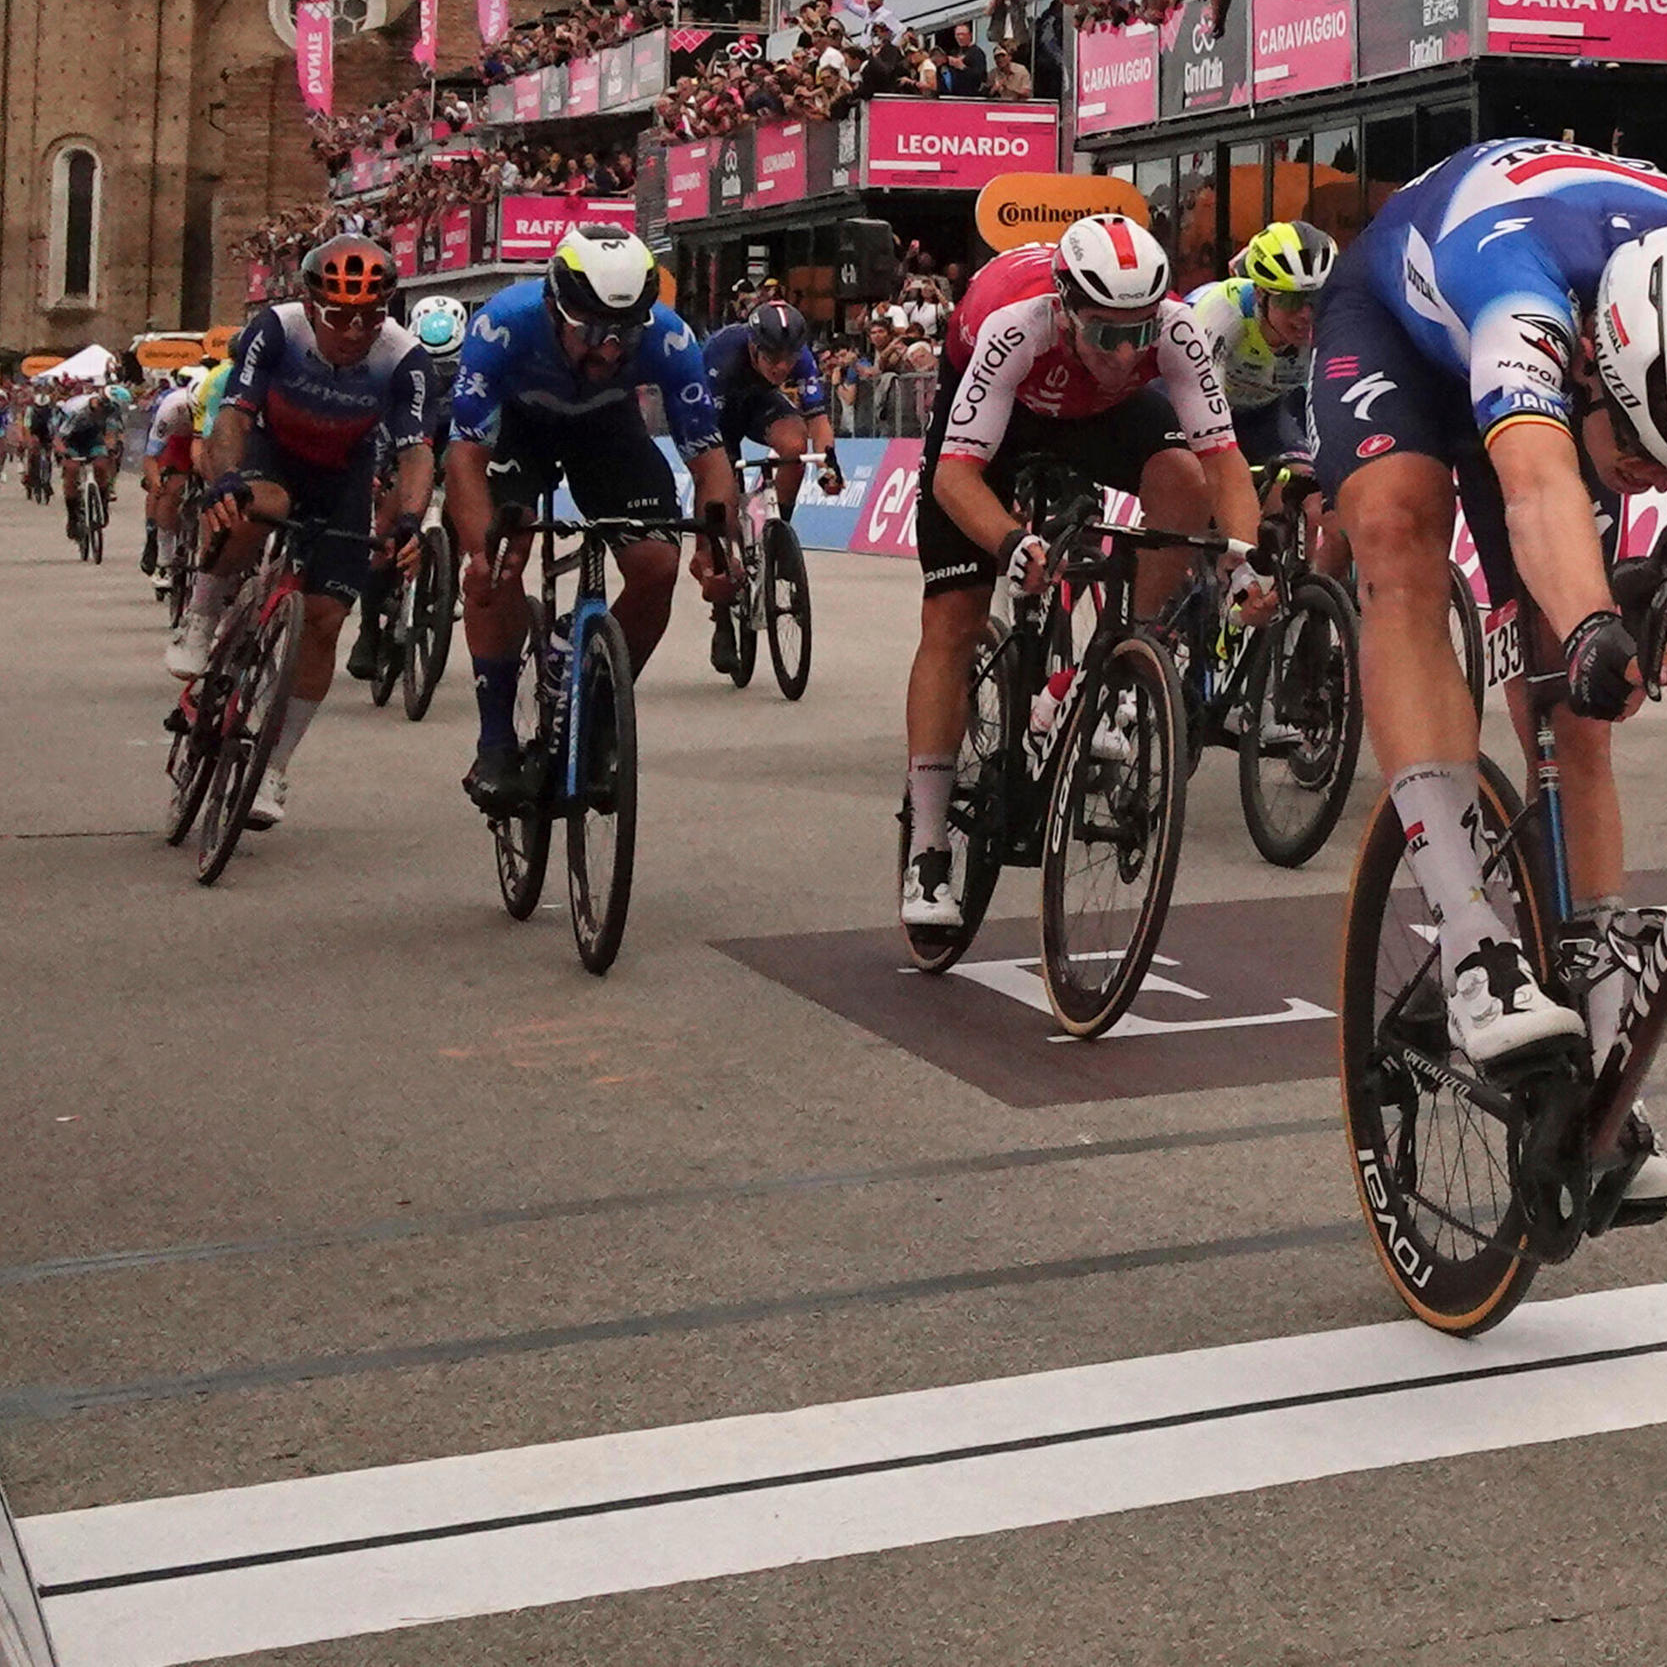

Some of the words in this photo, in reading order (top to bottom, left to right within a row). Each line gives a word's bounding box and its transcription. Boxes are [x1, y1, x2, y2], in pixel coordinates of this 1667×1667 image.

[1259, 10, 1348, 56] CARAVAGGIO
[1081, 56, 1153, 94] CARAVAGGIO
[896, 134, 1030, 158] LEONARDO
[950, 325, 1026, 426] Cofidis
[1169, 320, 1229, 416] Cofidis
[1356, 1147, 1435, 1290] roval
